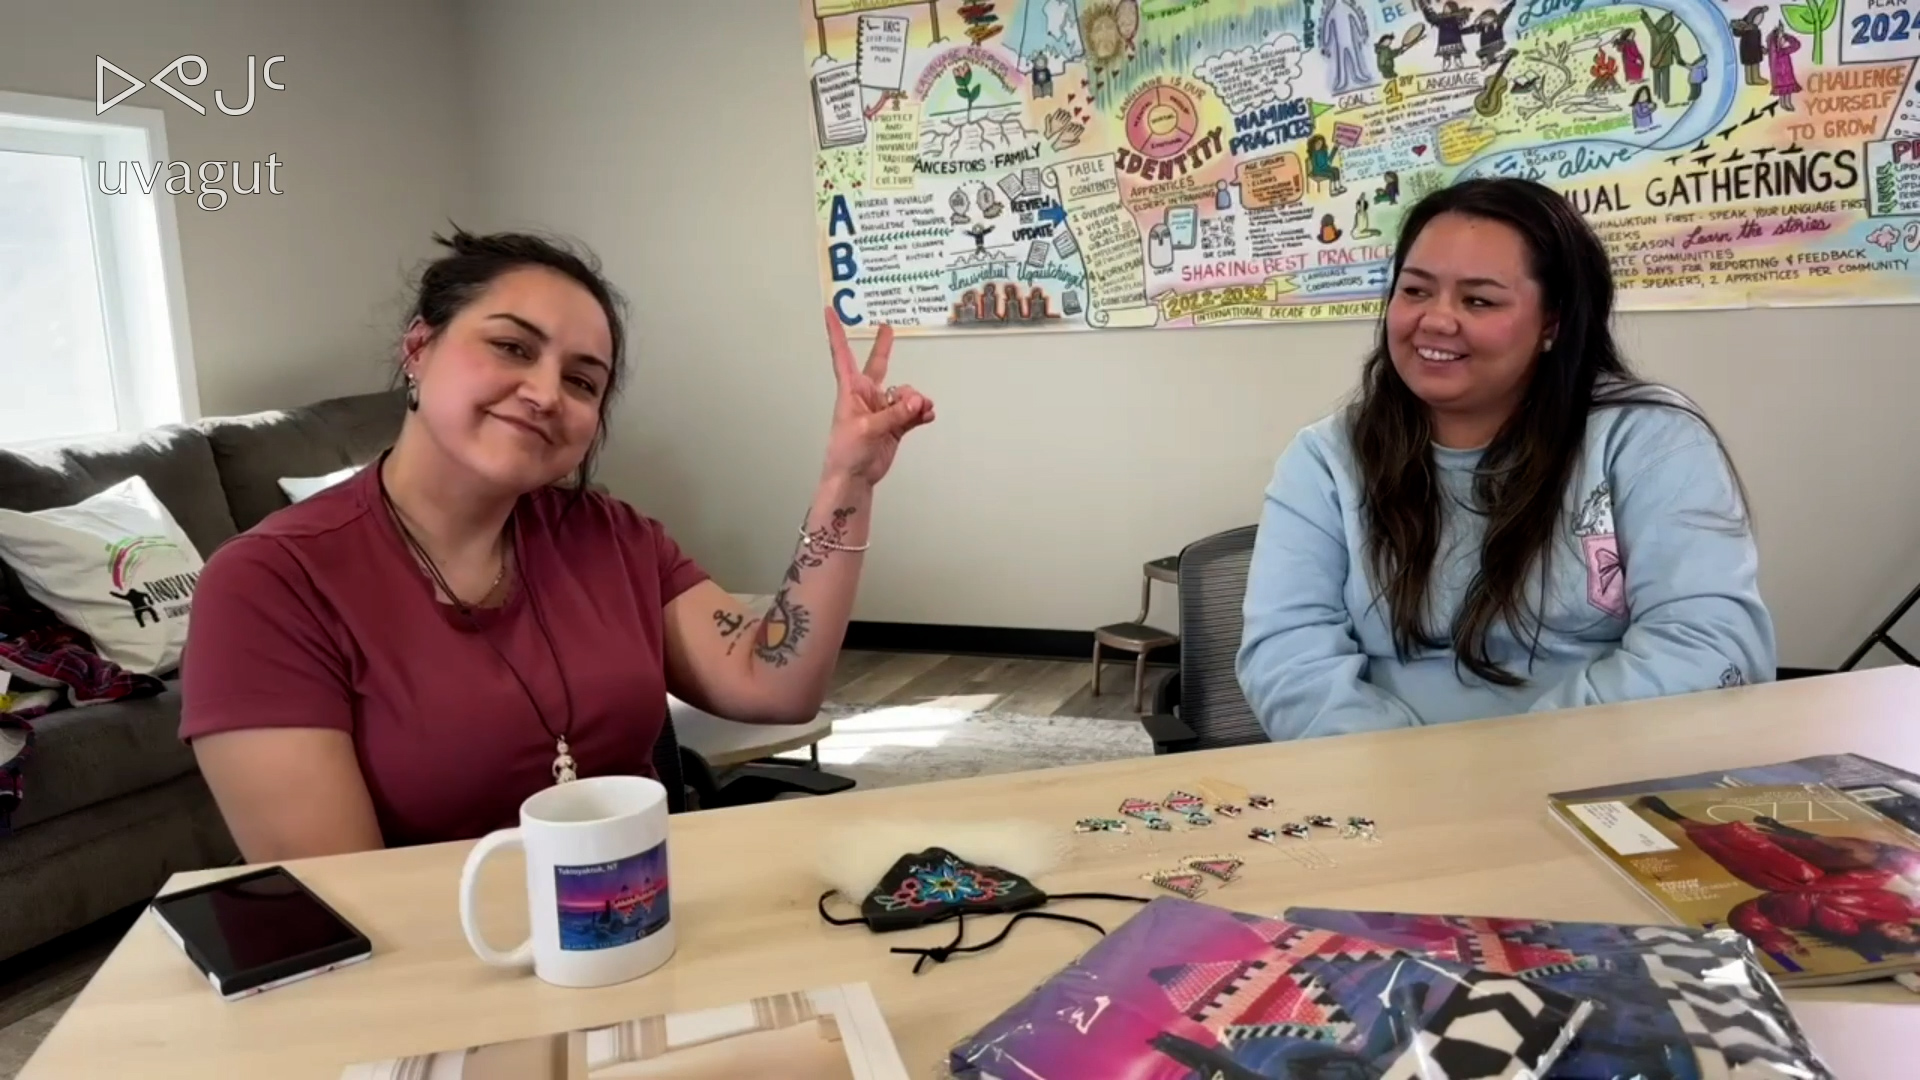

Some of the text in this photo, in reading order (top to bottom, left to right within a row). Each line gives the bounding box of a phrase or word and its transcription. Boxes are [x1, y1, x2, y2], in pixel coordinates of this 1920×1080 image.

[1161, 6, 1186, 18] FROM
[1303, 0, 1314, 48] IDE
[1382, 3, 1406, 23] BE
[1417, 73, 1479, 93] LANGUAGE
[1807, 66, 1907, 94] CHALLENGE
[1116, 76, 1162, 121] LANGUAGE
[1171, 76, 1182, 86] IS
[1184, 81, 1206, 101] OUR
[1804, 90, 1897, 116] YOURSELF
[1234, 97, 1306, 133] NAMING
[1787, 115, 1878, 141] TO GROW
[1228, 116, 1312, 156] PRACTICES
[913, 142, 1041, 175] ANCESTORS FAMILY
[1115, 126, 1223, 181] IDENTITY
[1245, 156, 1285, 171] AGE GROUPS
[1526, 150, 1567, 167] BOARD
[1558, 146, 1632, 179] alive
[1066, 159, 1104, 177] TABLE
[1645, 150, 1858, 207] GATHERINGS
[1070, 178, 1116, 197] CONTENTS
[1130, 175, 1195, 198] APPRENTICES
[829, 195, 856, 237] A
[1010, 194, 1050, 213] REVIEW
[1665, 212, 1696, 223] FIRST
[1709, 209, 1747, 221] SPEAK
[1753, 206, 1779, 218] YOUR
[1781, 201, 1836, 216] LANGUAGE
[1012, 223, 1054, 242] UPDATE
[1625, 237, 1675, 252] SEASON
[1682, 215, 1832, 250] Learn the stories
[829, 243, 858, 282] B
[1181, 258, 1260, 282] SHARING
[1263, 252, 1310, 274] BEST
[1643, 249, 1735, 266] COMMUNITIES
[1646, 264, 1674, 276] DAYS
[1682, 263, 1704, 274] FOR
[1709, 255, 1779, 271] REPORTING
[1797, 248, 1867, 264] FEEDBACK
[1302, 267, 1347, 283] LANGUAGE
[1306, 276, 1364, 293] COORDINATORS
[1709, 275, 1720, 285] 2
[1725, 269, 1800, 284] APPRENTICES
[1809, 265, 1832, 277] PER
[1838, 258, 1909, 275] COMMUNITY
[833, 288, 863, 326] C
[1167, 283, 1269, 320] 2022-2032
[1196, 303, 1263, 323] INTERNATIONAL
[1270, 304, 1304, 318] DECADE
[1310, 303, 1324, 317] OF
[606, 863, 619, 872] NT
